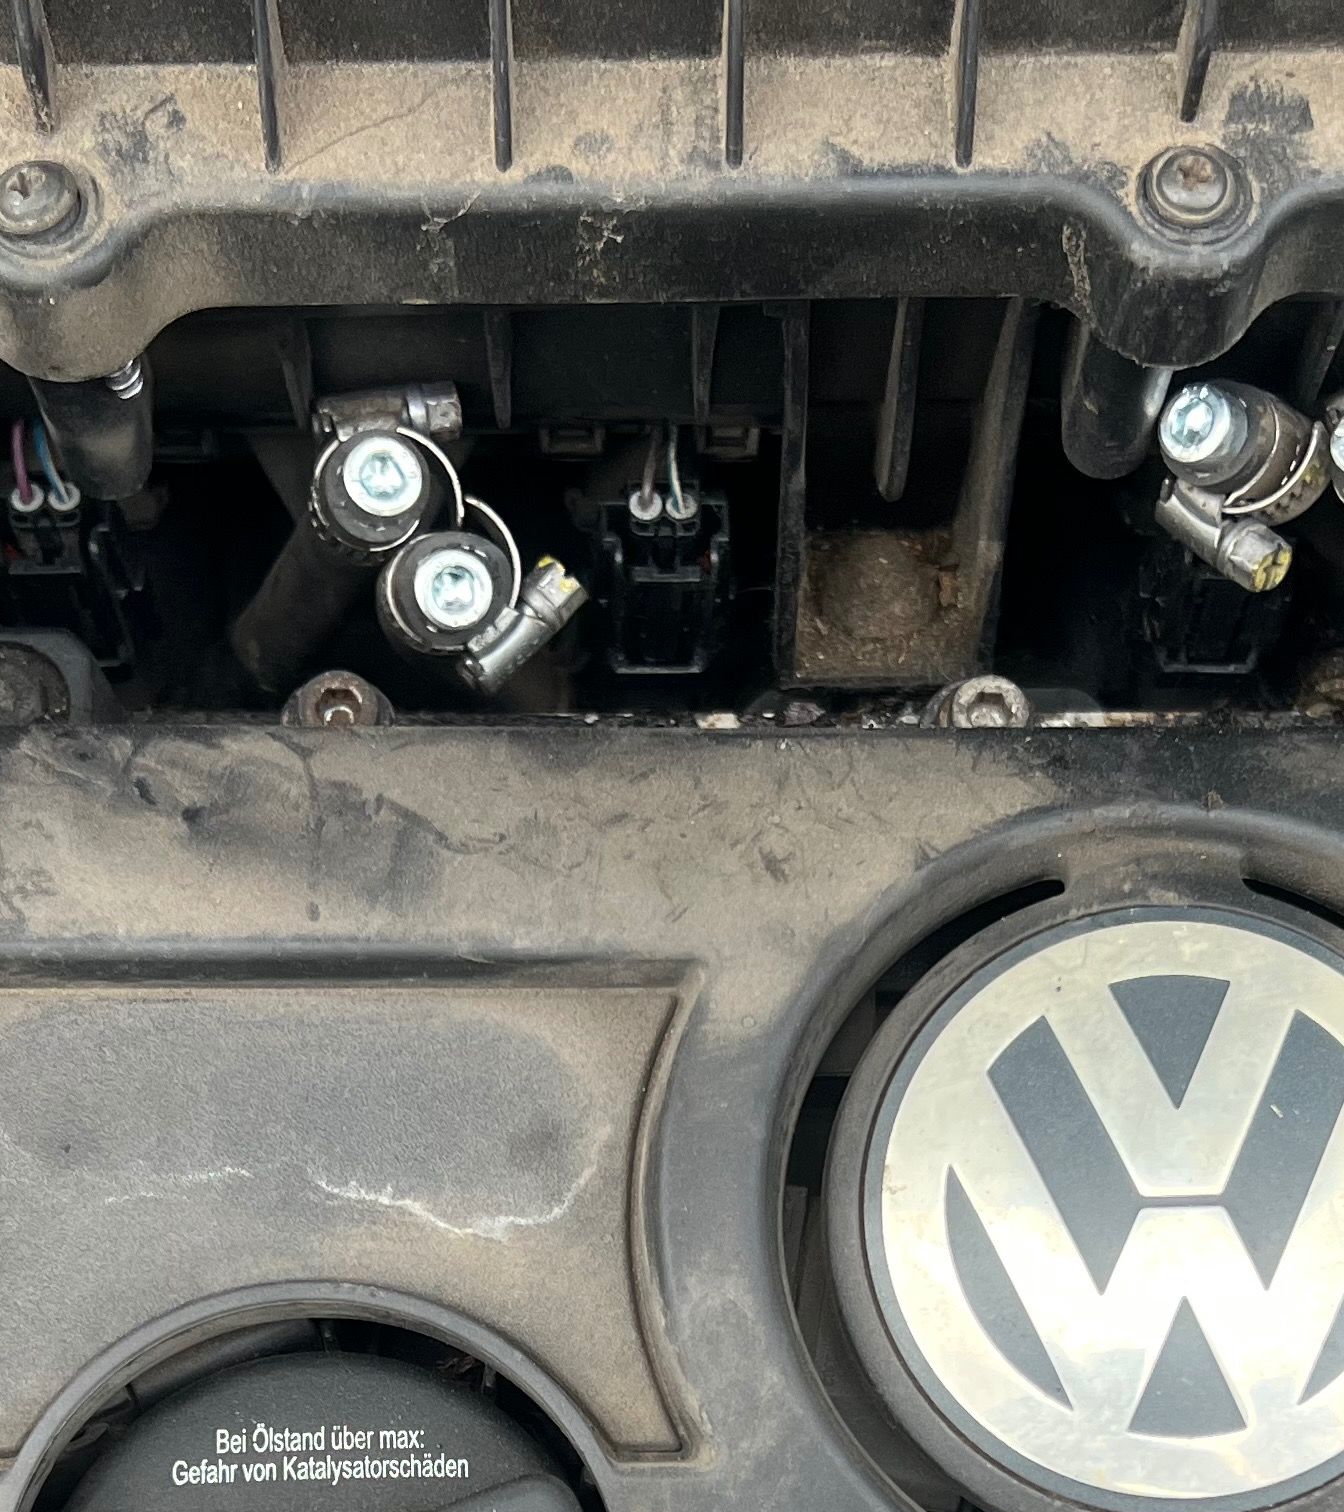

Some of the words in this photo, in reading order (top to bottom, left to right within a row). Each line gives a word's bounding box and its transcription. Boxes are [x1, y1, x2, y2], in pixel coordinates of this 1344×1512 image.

[216, 1428, 247, 1454] Bei
[252, 1422, 325, 1453] Ölstand
[330, 1425, 375, 1451] über
[379, 1429, 425, 1449] max:
[172, 1458, 238, 1486] Gefahr
[242, 1463, 277, 1482] von
[283, 1453, 469, 1486] Katalysatorschäden
